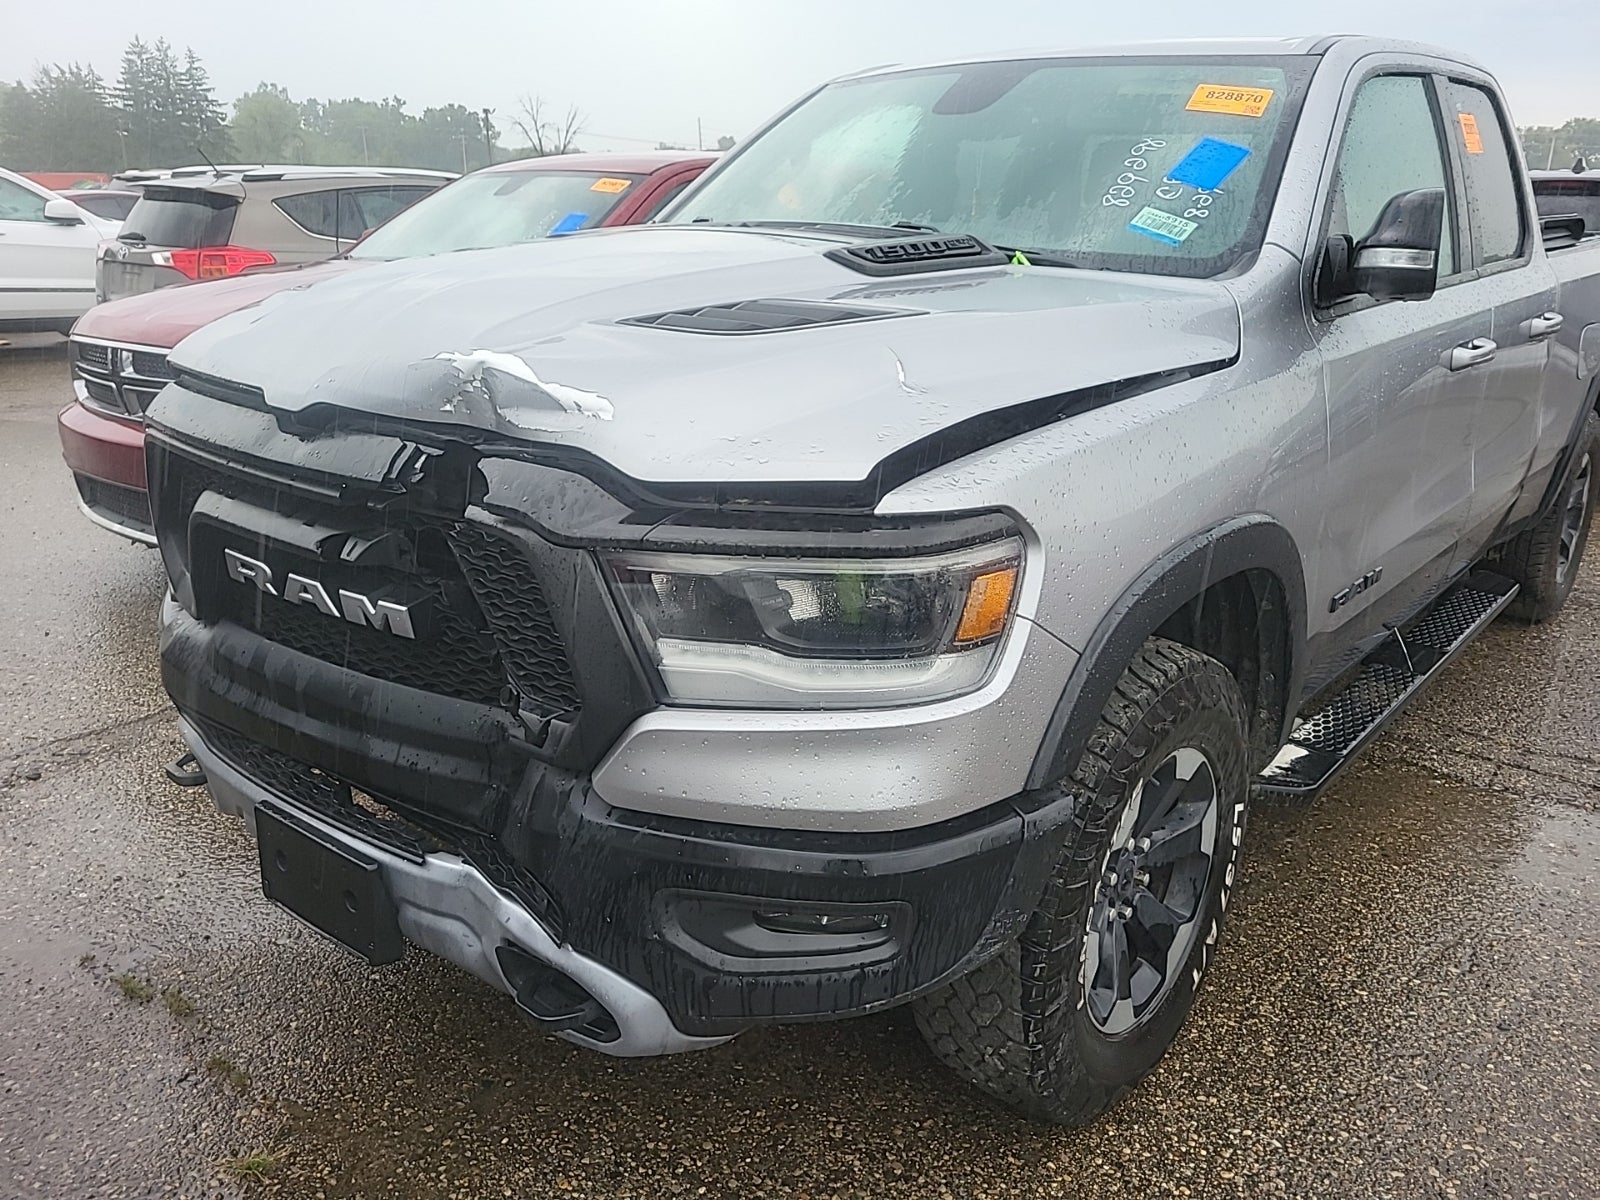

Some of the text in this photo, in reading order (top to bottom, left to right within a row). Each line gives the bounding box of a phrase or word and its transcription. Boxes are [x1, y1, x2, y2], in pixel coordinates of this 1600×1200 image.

[1205, 91, 1264, 103] 828870
[865, 240, 948, 259] 1500
[224, 548, 416, 640] RAM
[1327, 566, 1384, 614] RAM
